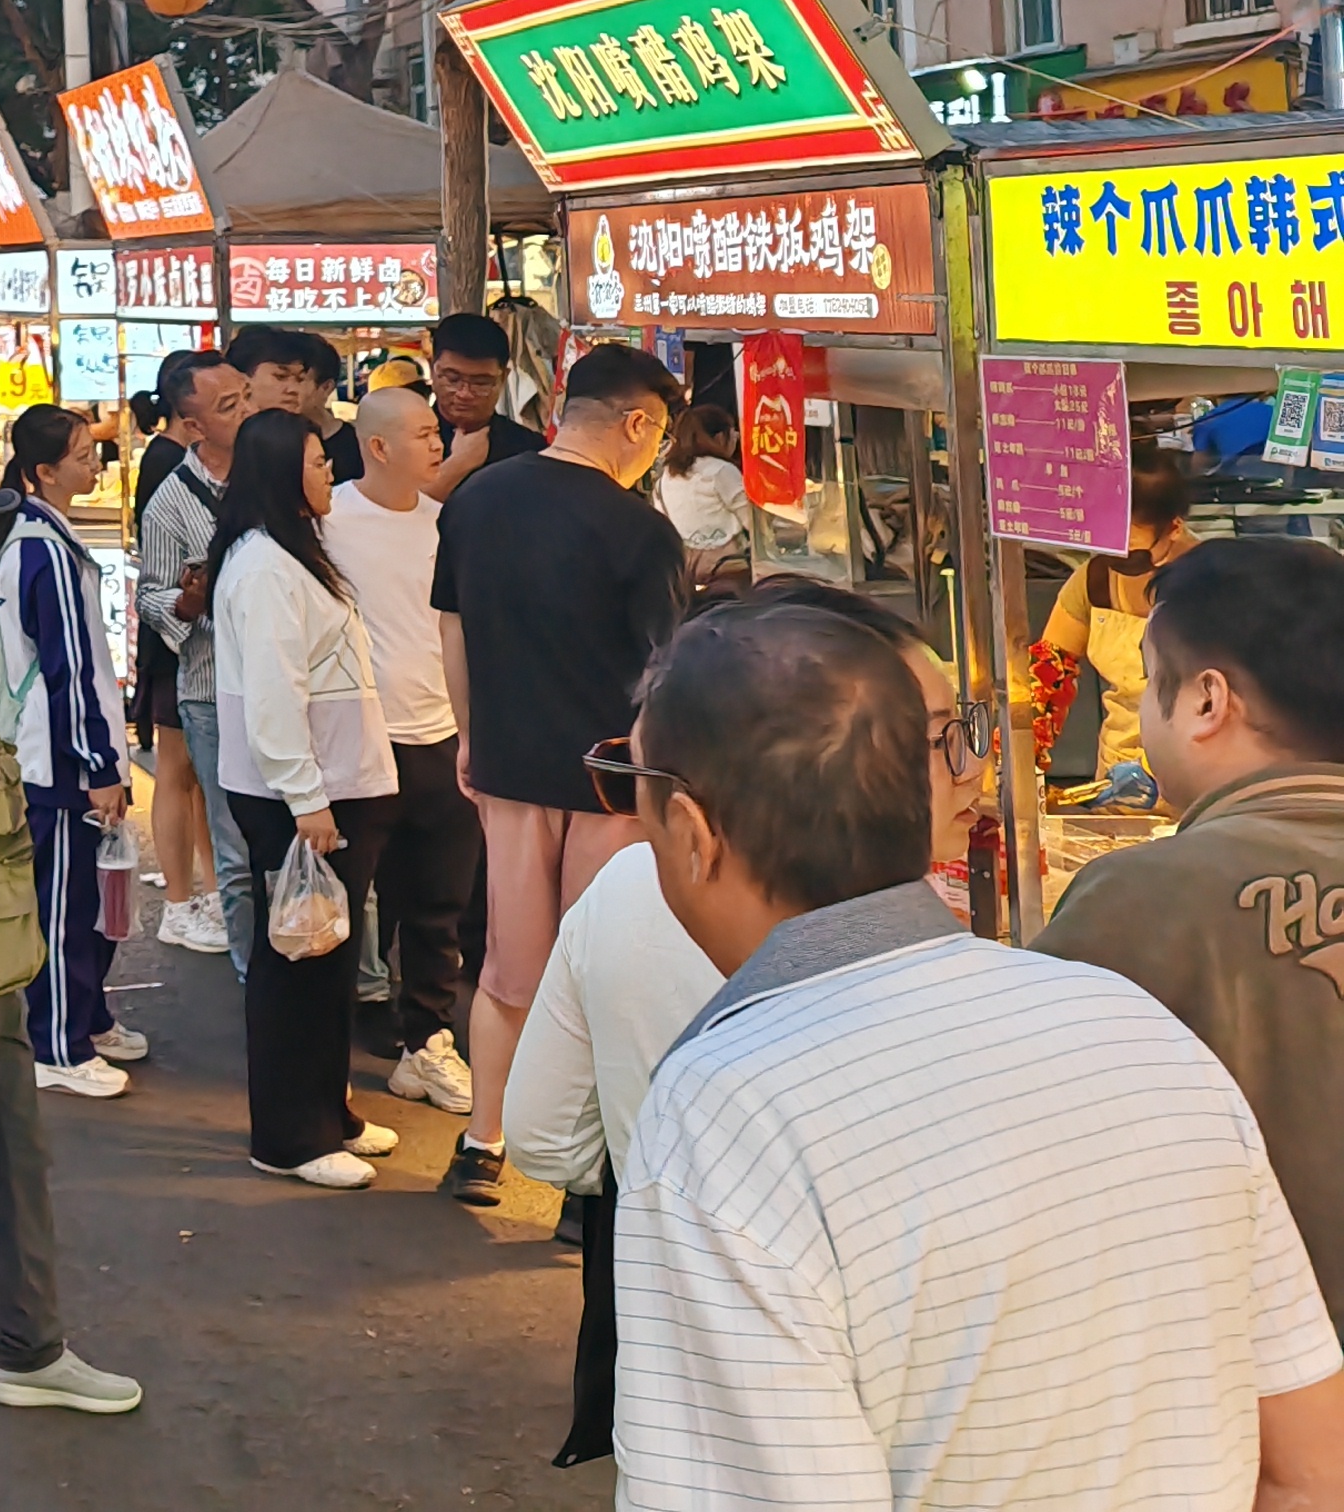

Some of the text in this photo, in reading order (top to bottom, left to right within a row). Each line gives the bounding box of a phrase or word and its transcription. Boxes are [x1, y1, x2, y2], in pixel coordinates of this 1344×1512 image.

[520, 8, 786, 119] 沈阳喷醋鸡架
[629, 194, 876, 279] 沈阳喷醋铁板鸡架
[1041, 171, 1344, 257] 辣个爪爪韩式
[265, 256, 401, 285] 每日新鲜卤
[265, 286, 404, 314] 好吃不上火
[1165, 279, 1331, 339] 좋아해
